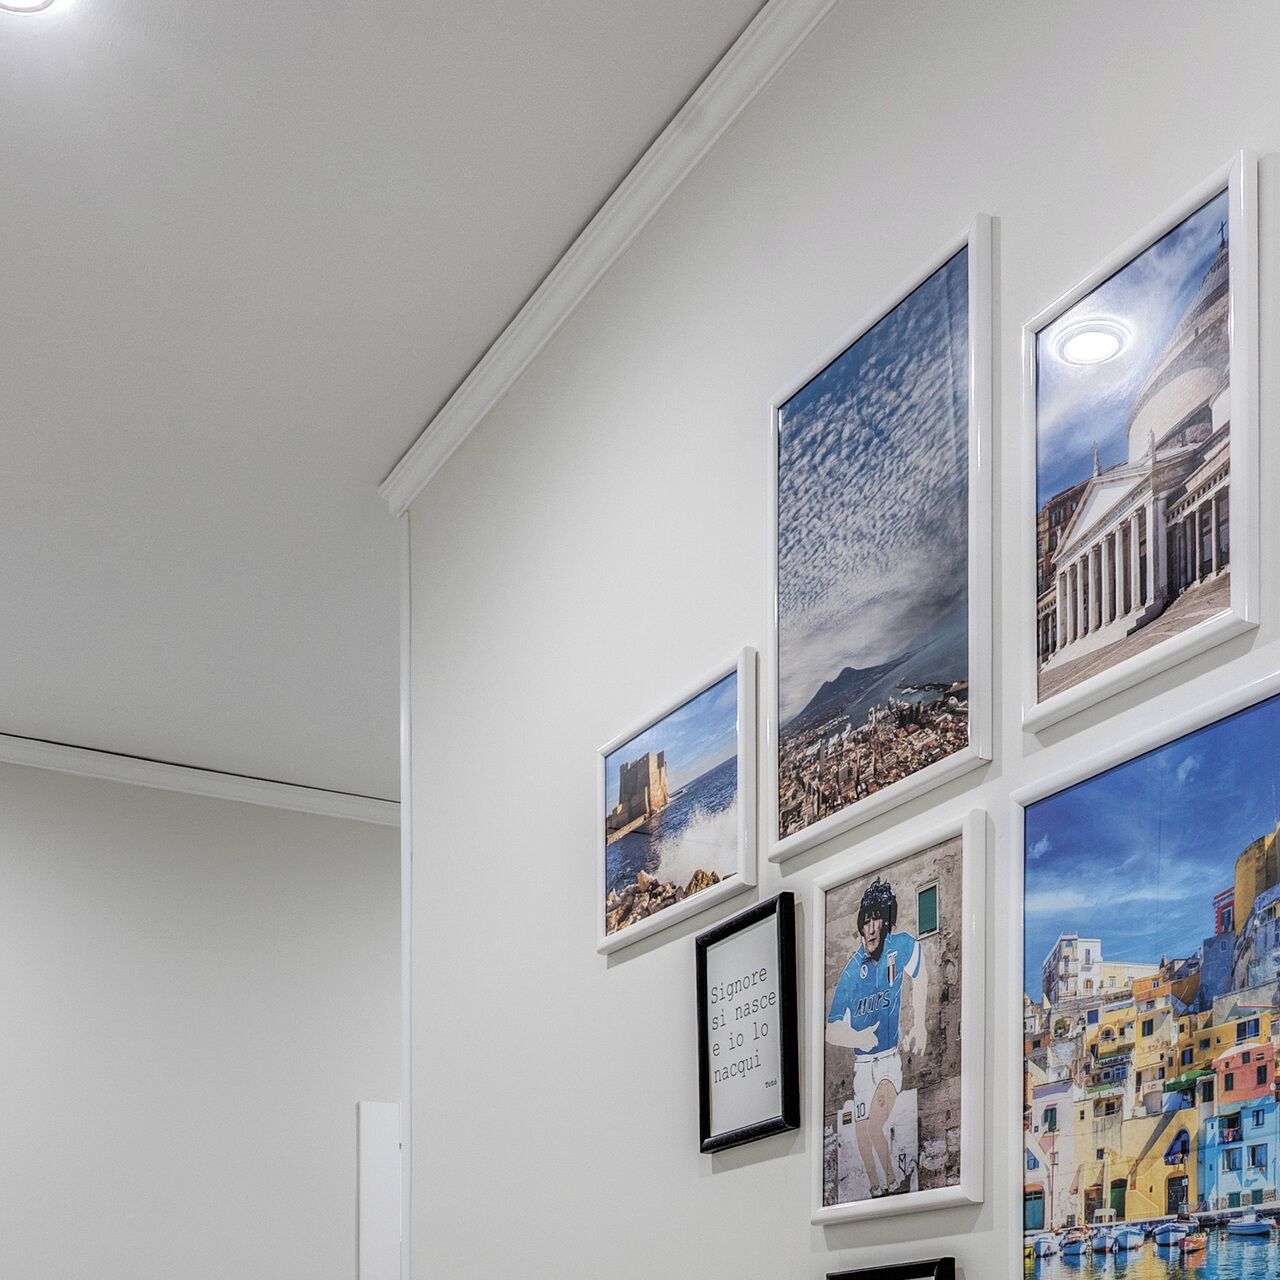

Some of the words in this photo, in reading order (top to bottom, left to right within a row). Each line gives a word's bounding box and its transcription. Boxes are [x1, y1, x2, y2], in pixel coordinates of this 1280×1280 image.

[711, 967, 768, 1004] Signore
[712, 1008, 726, 1031] si
[735, 991, 776, 1020] nasce
[713, 1043, 720, 1056] e
[729, 1032, 744, 1050] io
[753, 1022, 768, 1040] lo
[714, 1050, 761, 1084] nacqui
[856, 1102, 865, 1118] 10
